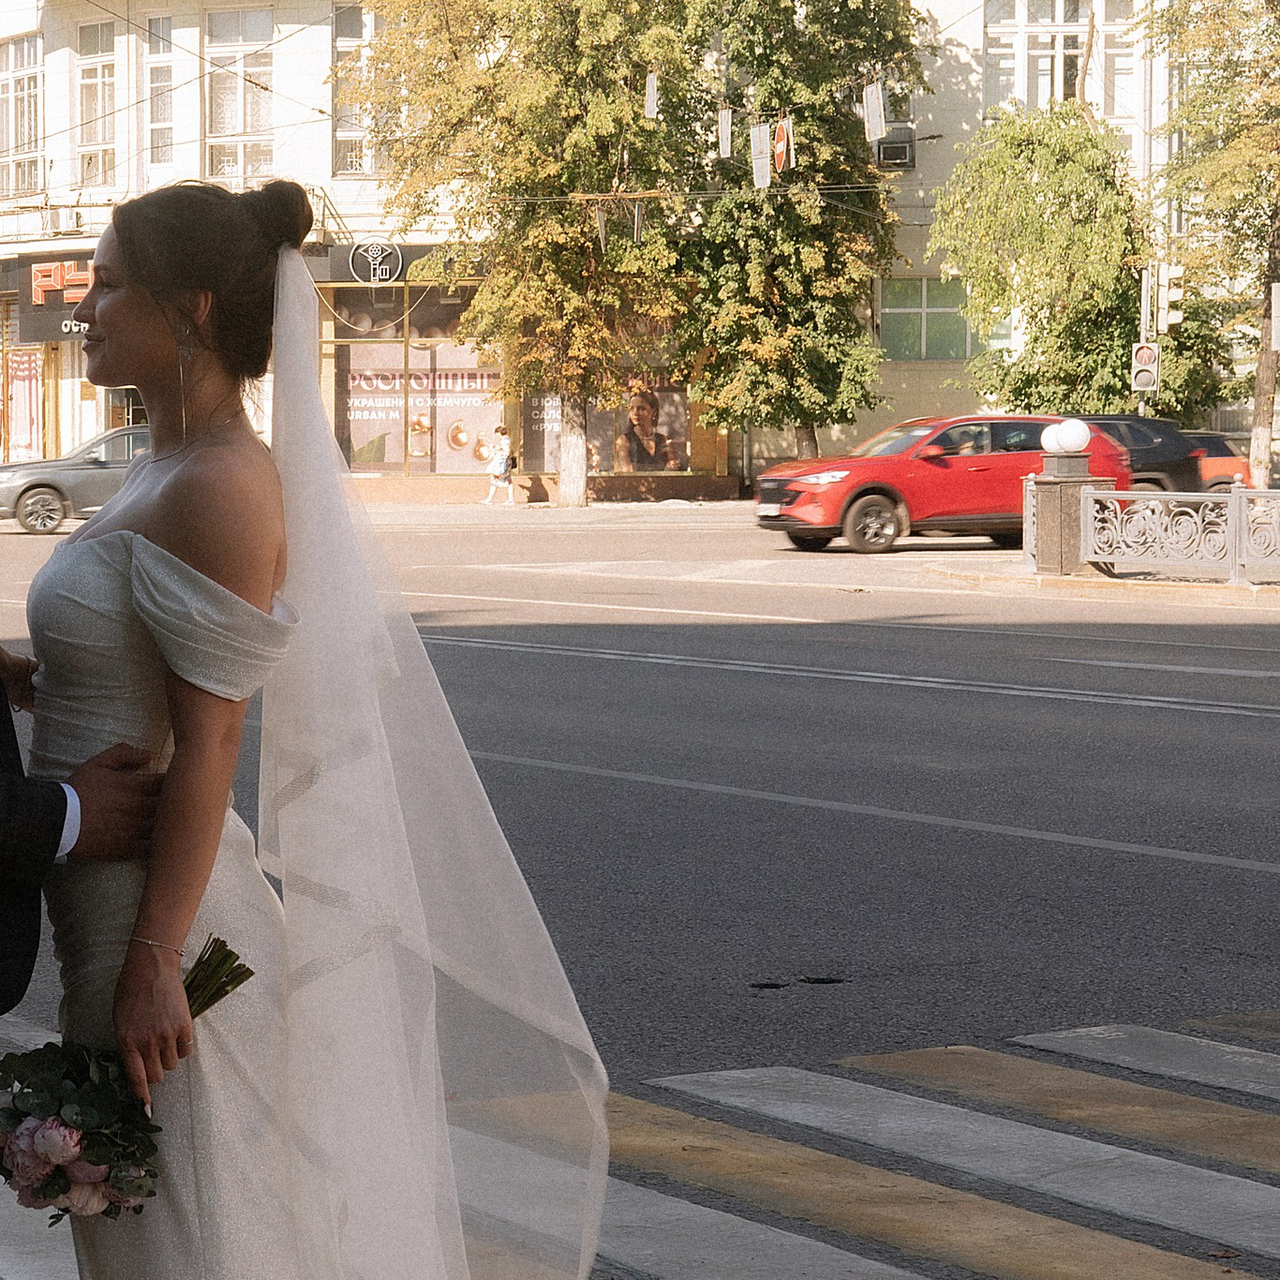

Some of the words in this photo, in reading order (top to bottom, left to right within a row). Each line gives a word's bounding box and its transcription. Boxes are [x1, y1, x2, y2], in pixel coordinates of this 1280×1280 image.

[347, 410, 386, 420] URBAN
[389, 410, 400, 419] M
[531, 422, 562, 432] «РУБ
